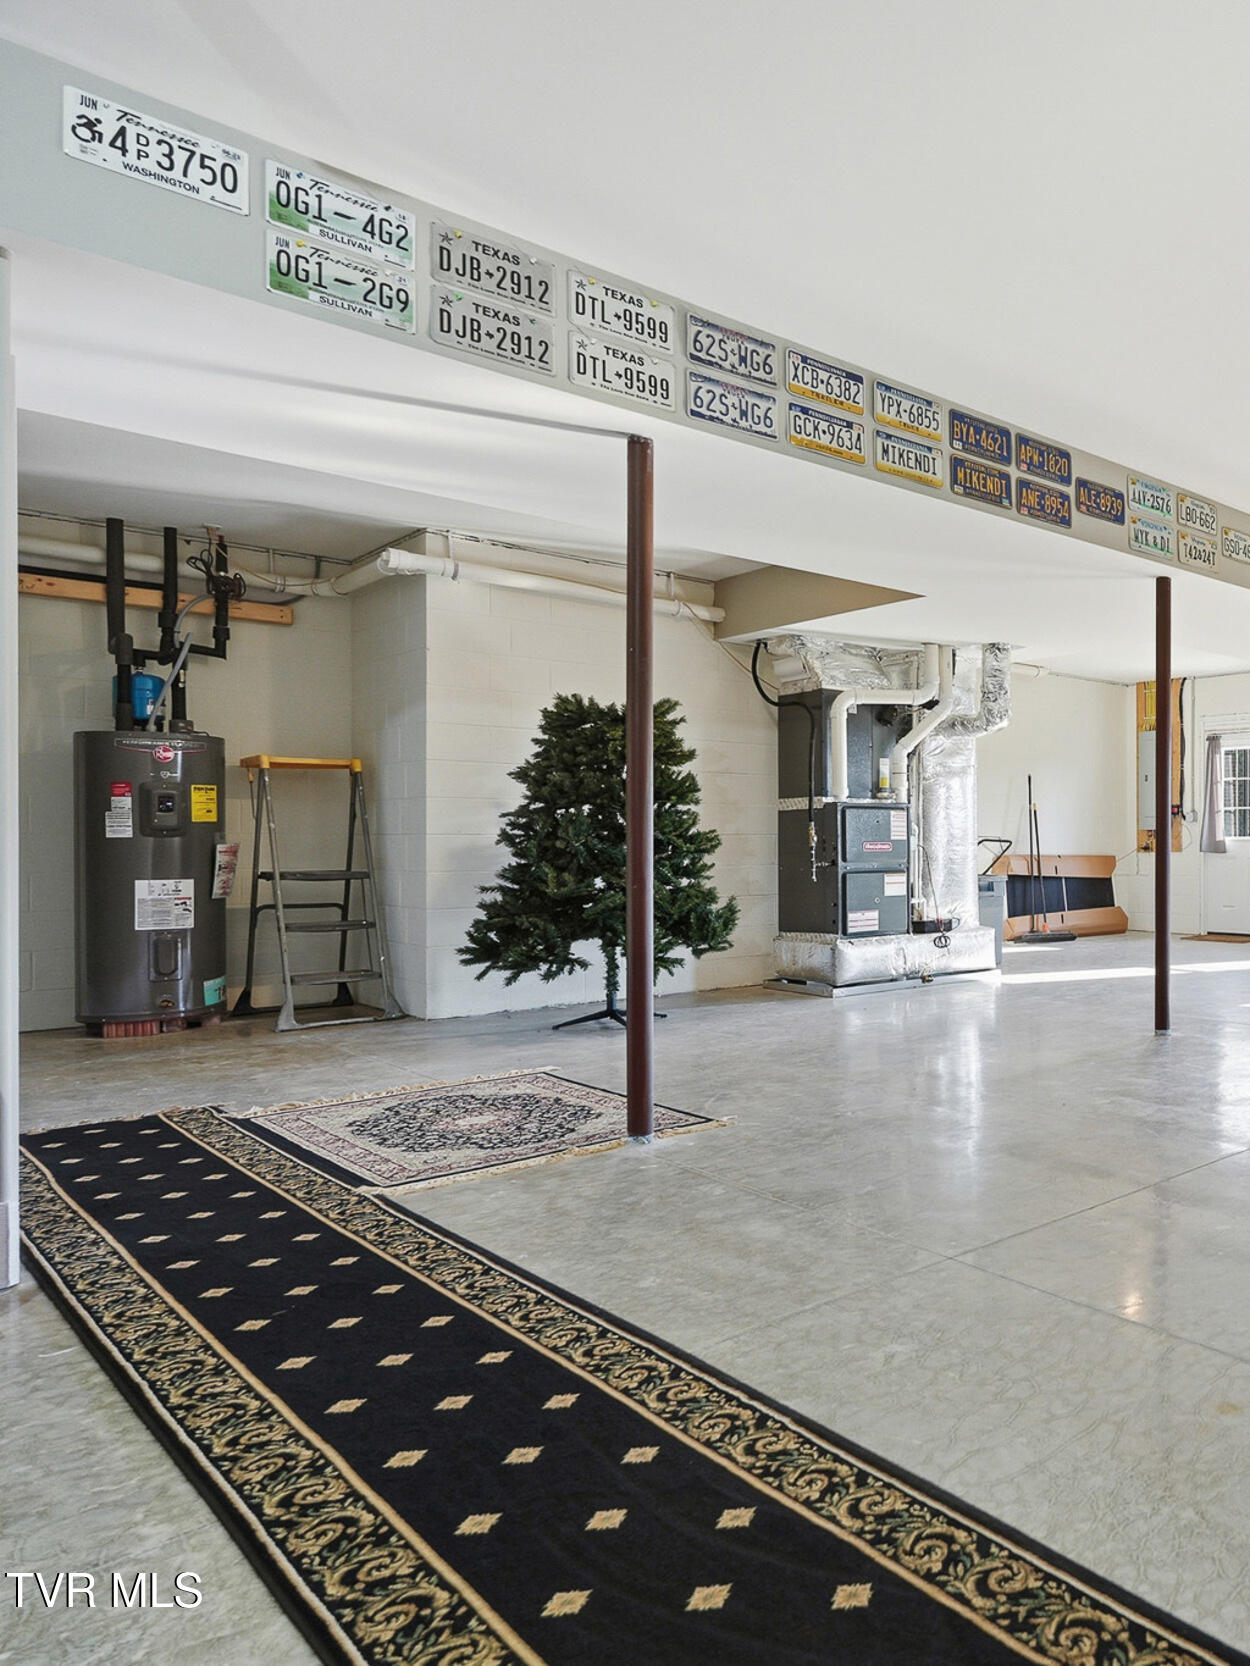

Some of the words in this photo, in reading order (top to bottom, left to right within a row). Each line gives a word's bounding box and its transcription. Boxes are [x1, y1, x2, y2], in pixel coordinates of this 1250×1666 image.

[80, 95, 98, 110] JUN
[116, 109, 200, 148] Tennessee
[122, 161, 200, 194] WASHINGTON
[275, 167, 291, 181] JUN
[307, 178, 379, 212] Tennessee
[275, 236, 290, 249] JUN
[319, 228, 372, 253] SULLIVAN
[307, 247, 379, 277] Tennessee
[472, 241, 521, 266] TEXAS
[319, 296, 373, 318] SULLIVAN
[603, 286, 644, 308] TEXAS
[472, 302, 521, 326] TEXAS
[603, 345, 645, 366] TEXAS
[881, 443, 937, 476] MIKENDI
[957, 466, 1008, 498] MIKENDI
